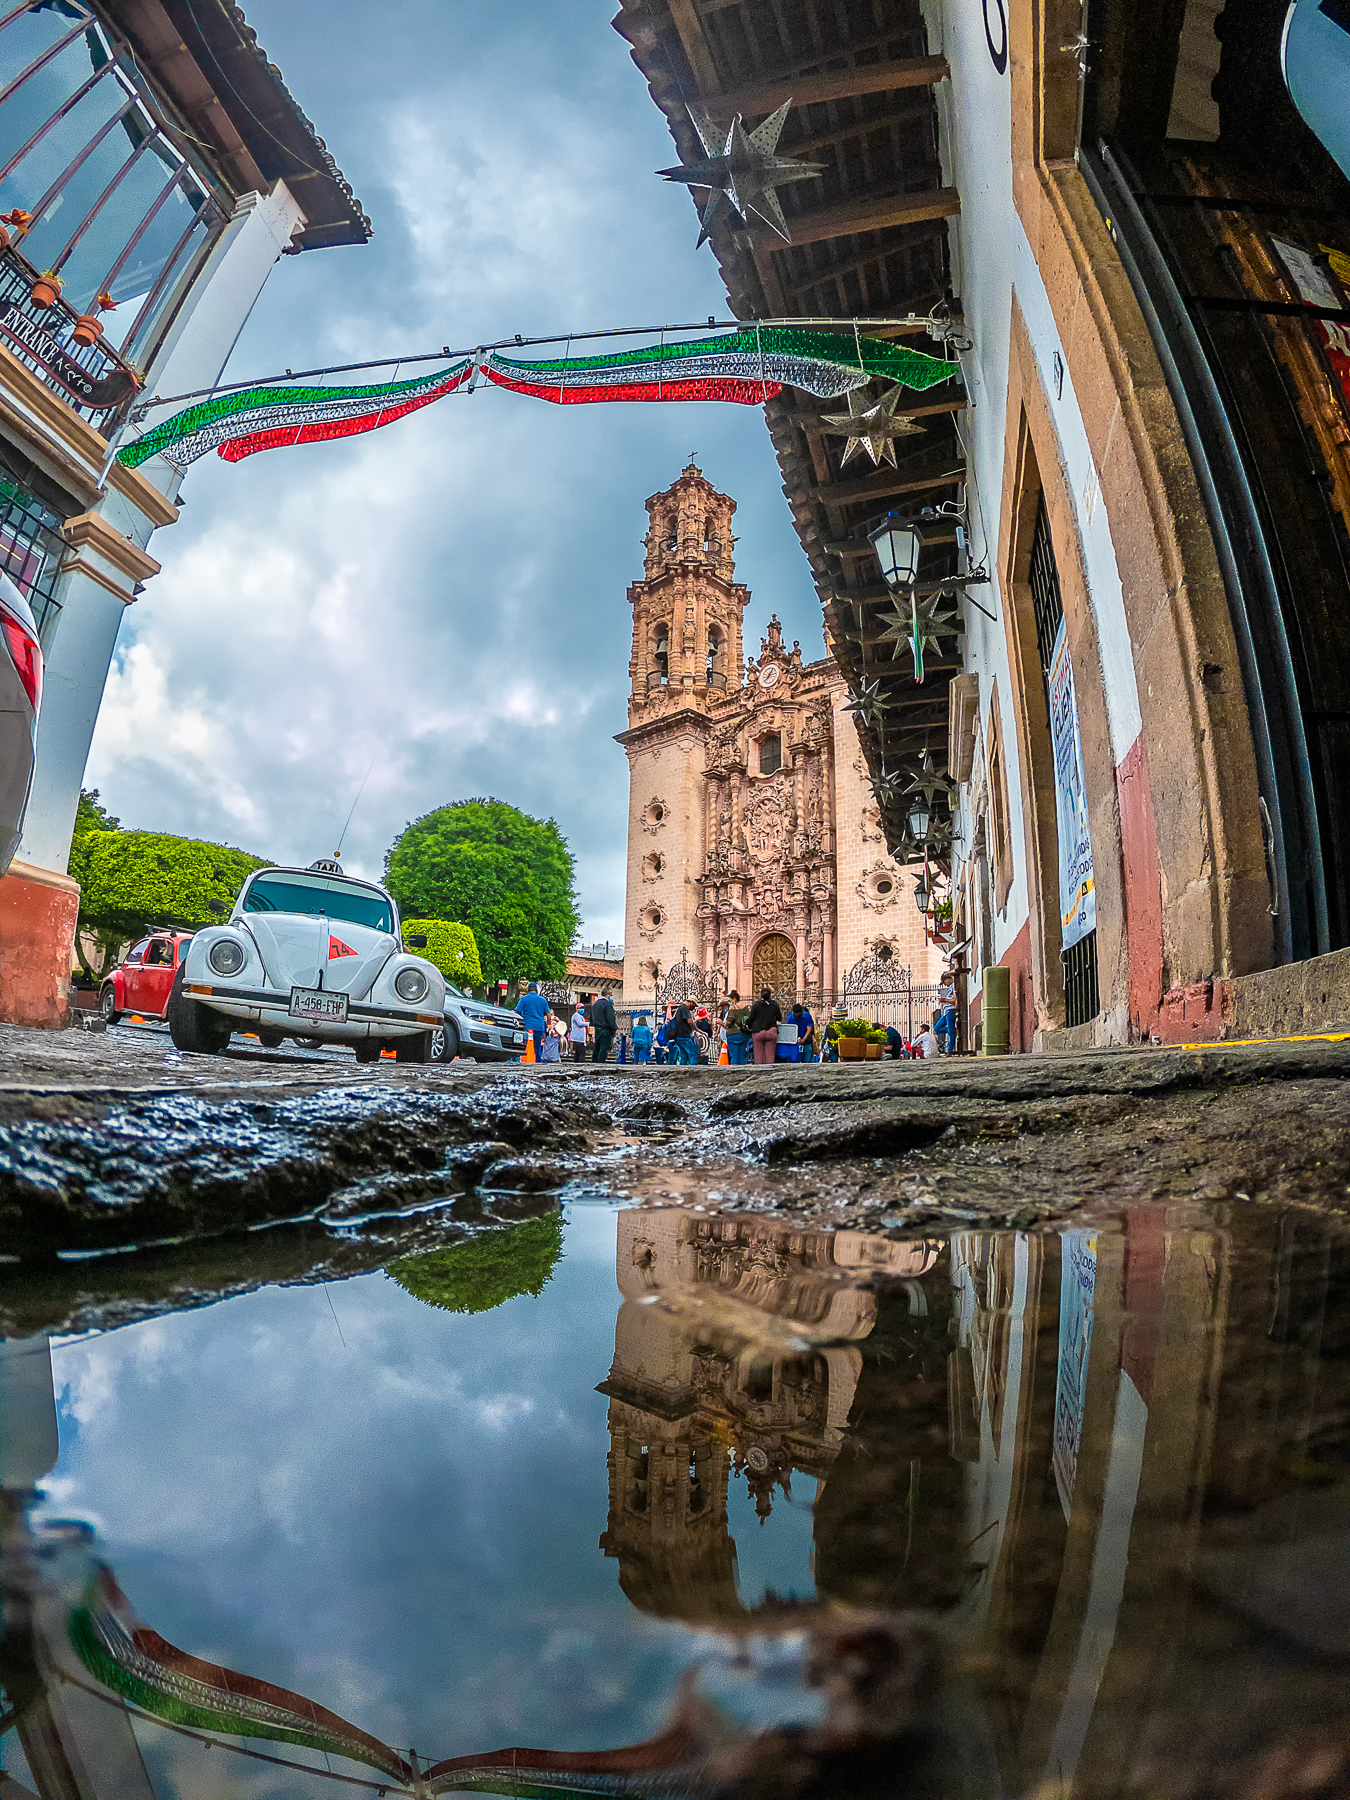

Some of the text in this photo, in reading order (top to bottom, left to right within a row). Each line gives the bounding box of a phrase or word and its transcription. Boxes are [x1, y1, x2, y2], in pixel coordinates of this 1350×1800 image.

[2, 306, 60, 364] ENTRANCE
[316, 861, 339, 873] TAXI
[331, 944, 350, 957] 74
[294, 995, 345, 1015] A-458-FHP
